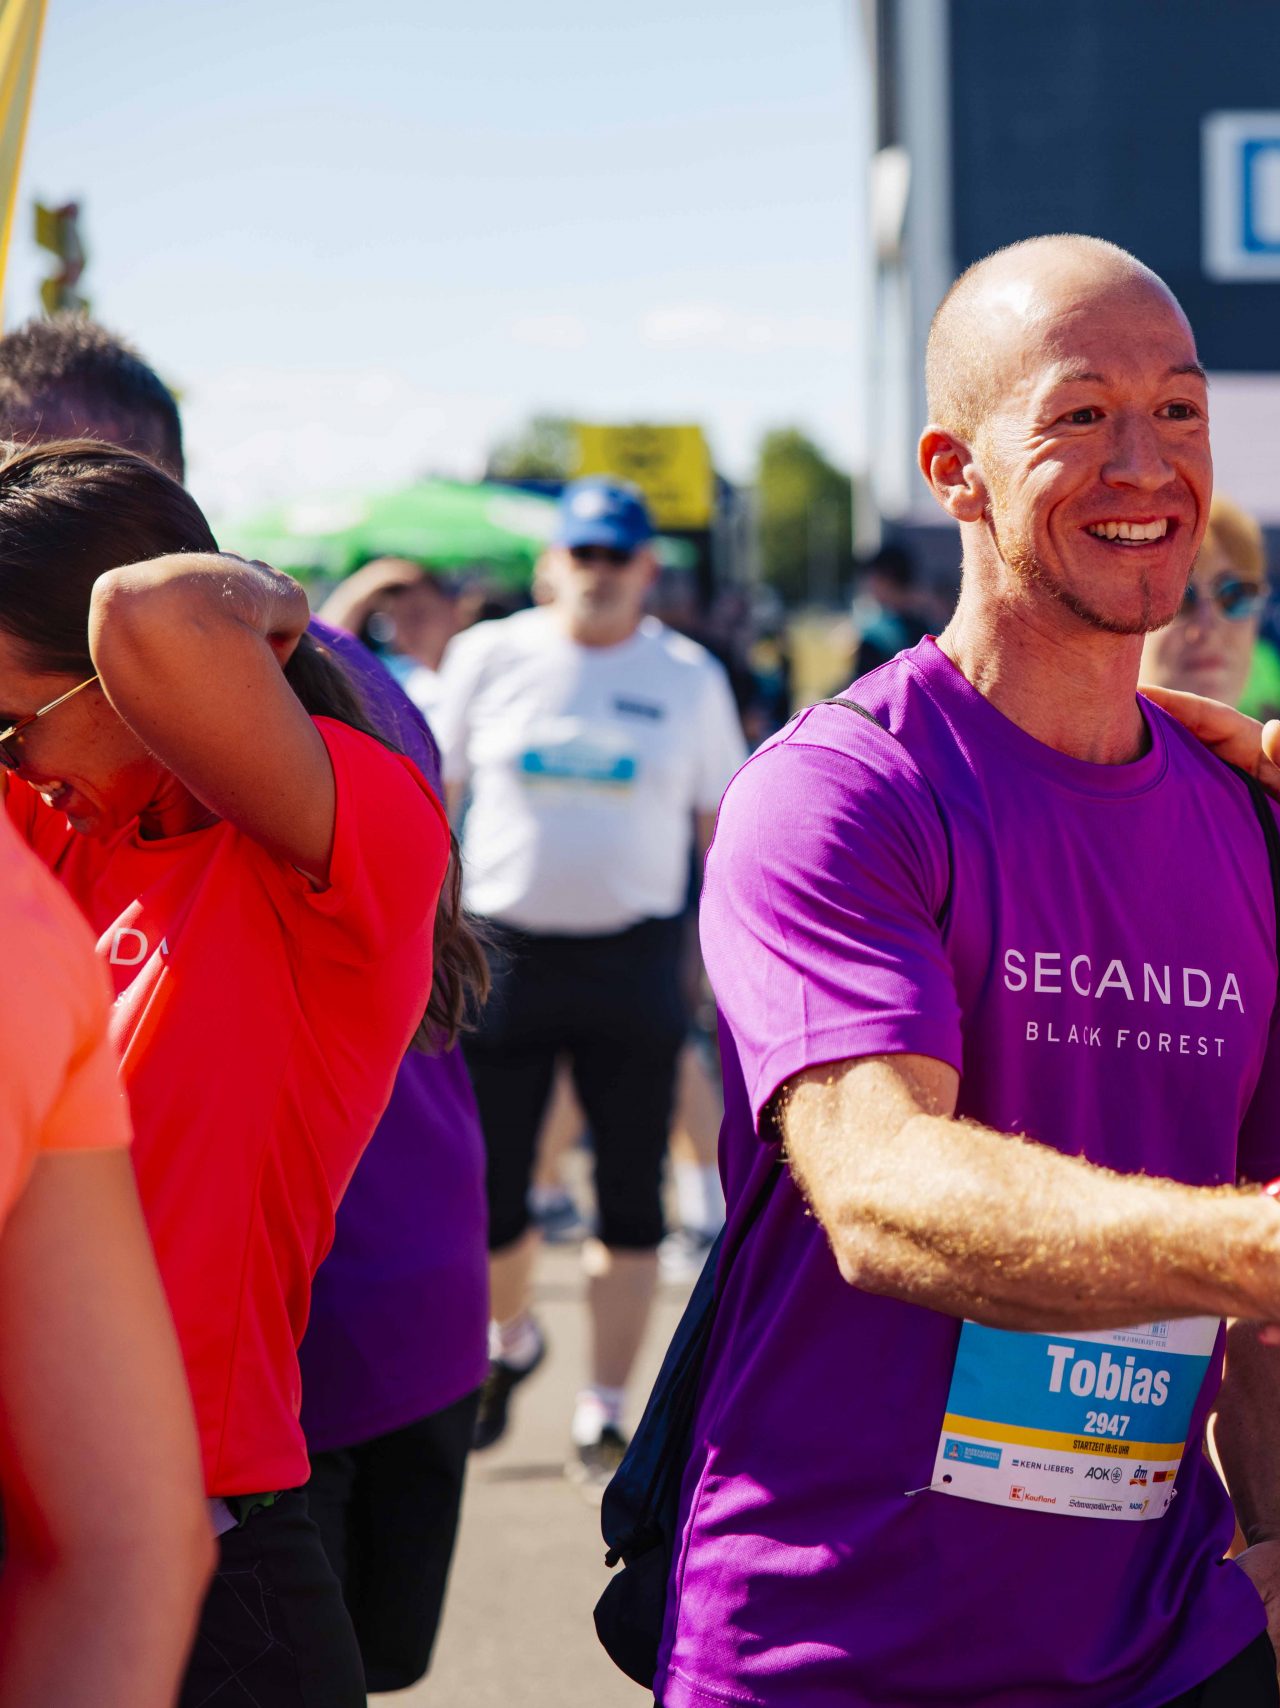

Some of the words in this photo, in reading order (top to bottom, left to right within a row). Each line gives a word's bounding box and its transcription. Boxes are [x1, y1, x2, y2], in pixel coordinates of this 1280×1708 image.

[1003, 949, 1245, 1014] SECANDA
[1026, 1021, 1101, 1047] BLACK
[1116, 1029, 1225, 1057] FOREST
[1047, 1344, 1171, 1406] Tobias
[1083, 1411, 1131, 1437] 2947
[1072, 1440, 1104, 1452] STARTZEIT
[1104, 1443, 1118, 1454] 18:15
[1118, 1445, 1130, 1455] UHR
[1020, 1460, 1042, 1470] KERN
[1043, 1463, 1074, 1475] LIEBERS
[1084, 1467, 1110, 1481] AOK
[1134, 1465, 1148, 1479] dm
[1024, 1493, 1057, 1504] Kaufland
